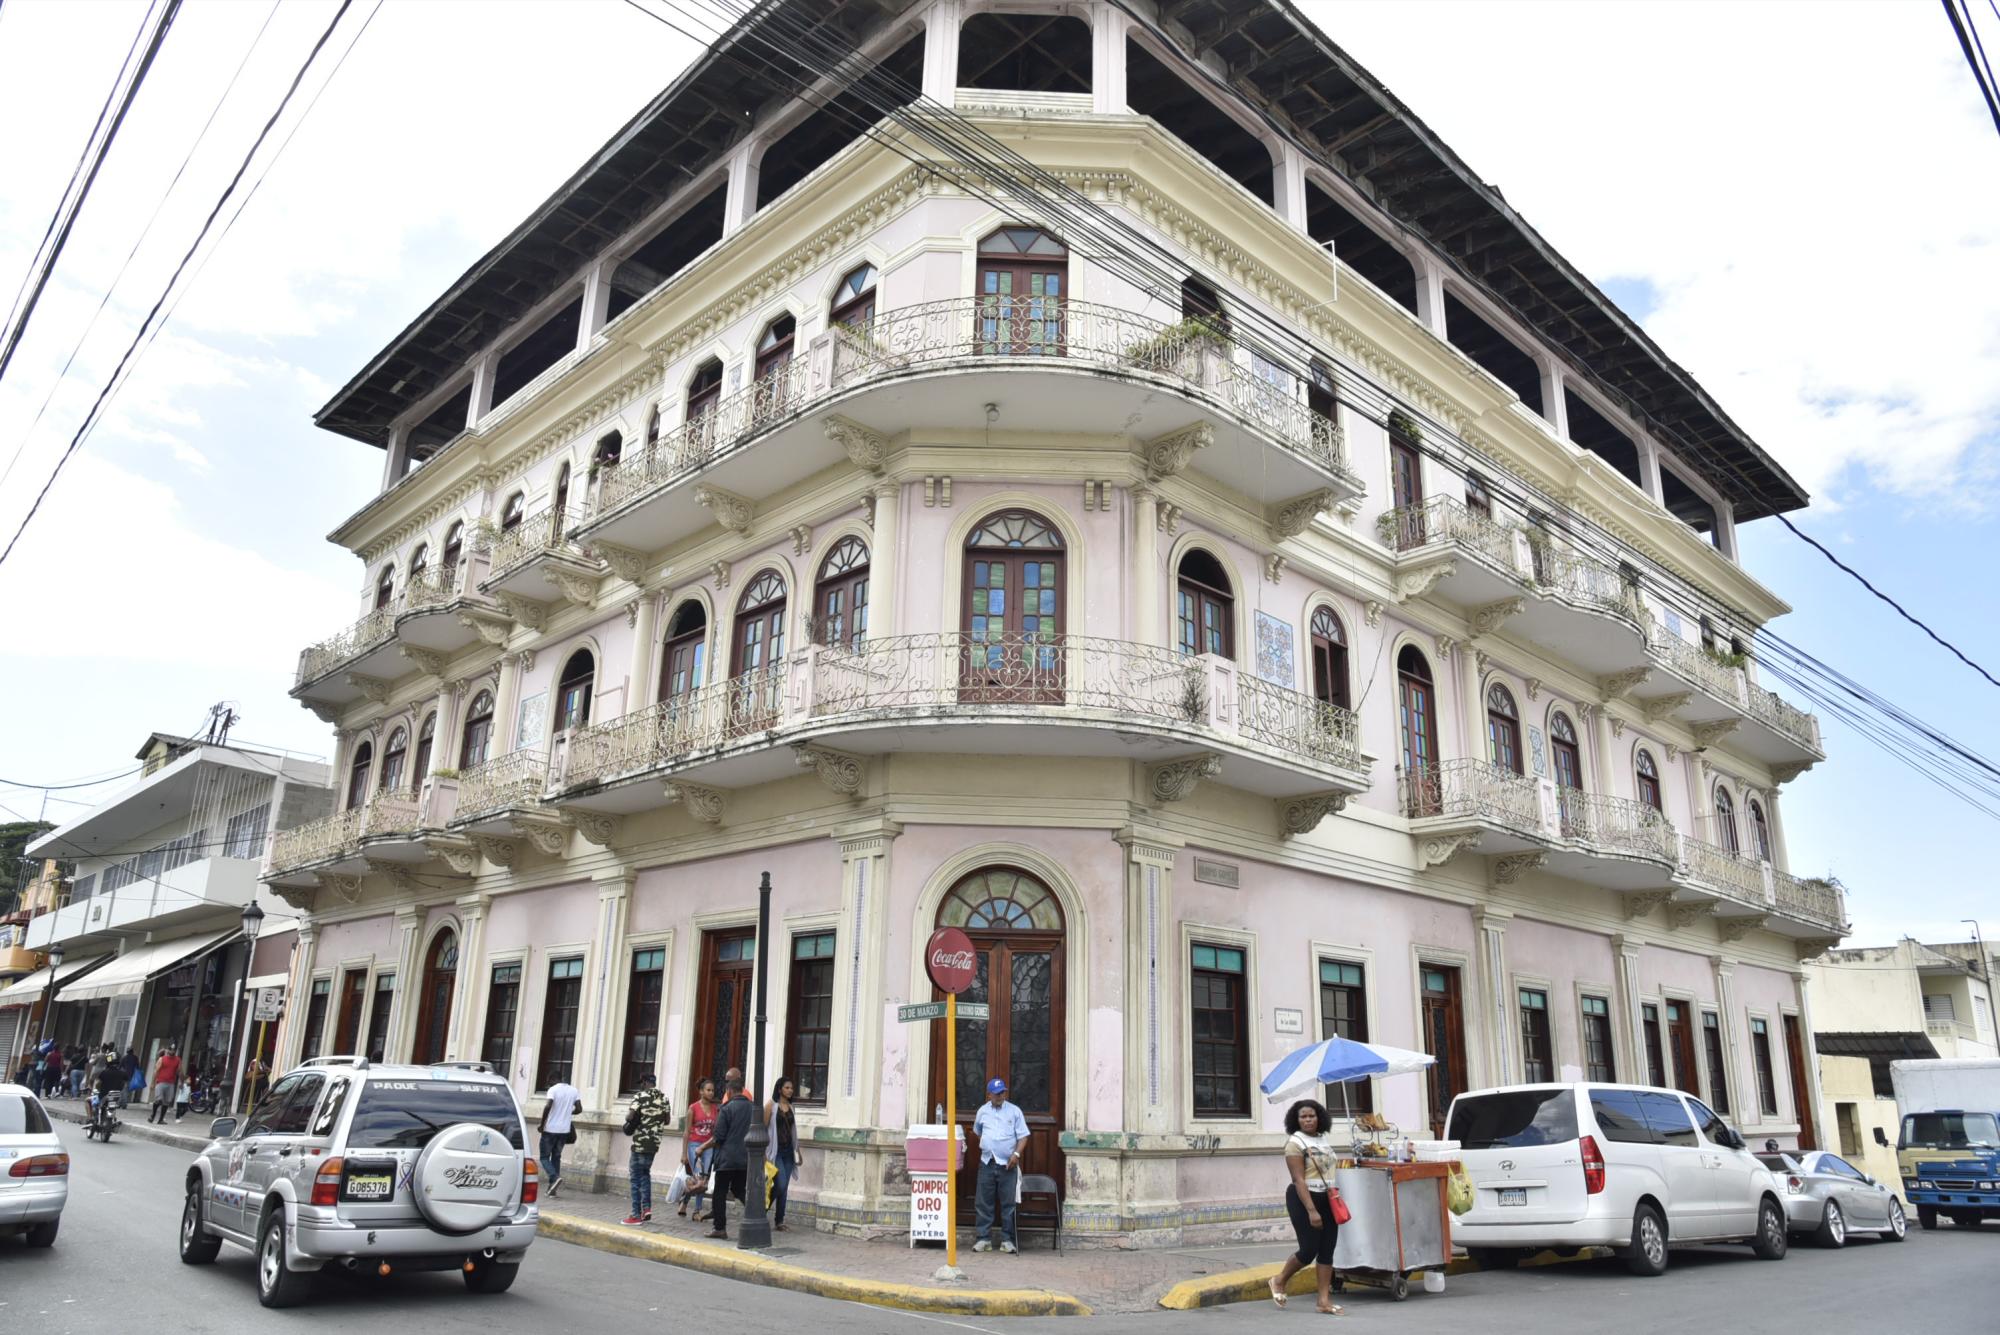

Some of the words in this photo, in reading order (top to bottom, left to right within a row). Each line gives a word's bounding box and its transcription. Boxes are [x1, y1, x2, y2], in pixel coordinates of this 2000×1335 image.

[899, 1010, 907, 1019] 30
[908, 1008, 916, 1017] DE
[916, 1005, 939, 1017] MARZO
[460, 1085, 499, 1094] SUFRA
[443, 1168, 498, 1189] Vitara
[350, 1182, 387, 1192] G085378
[912, 1180, 948, 1194] COMPRO
[917, 1197, 942, 1212] ORO
